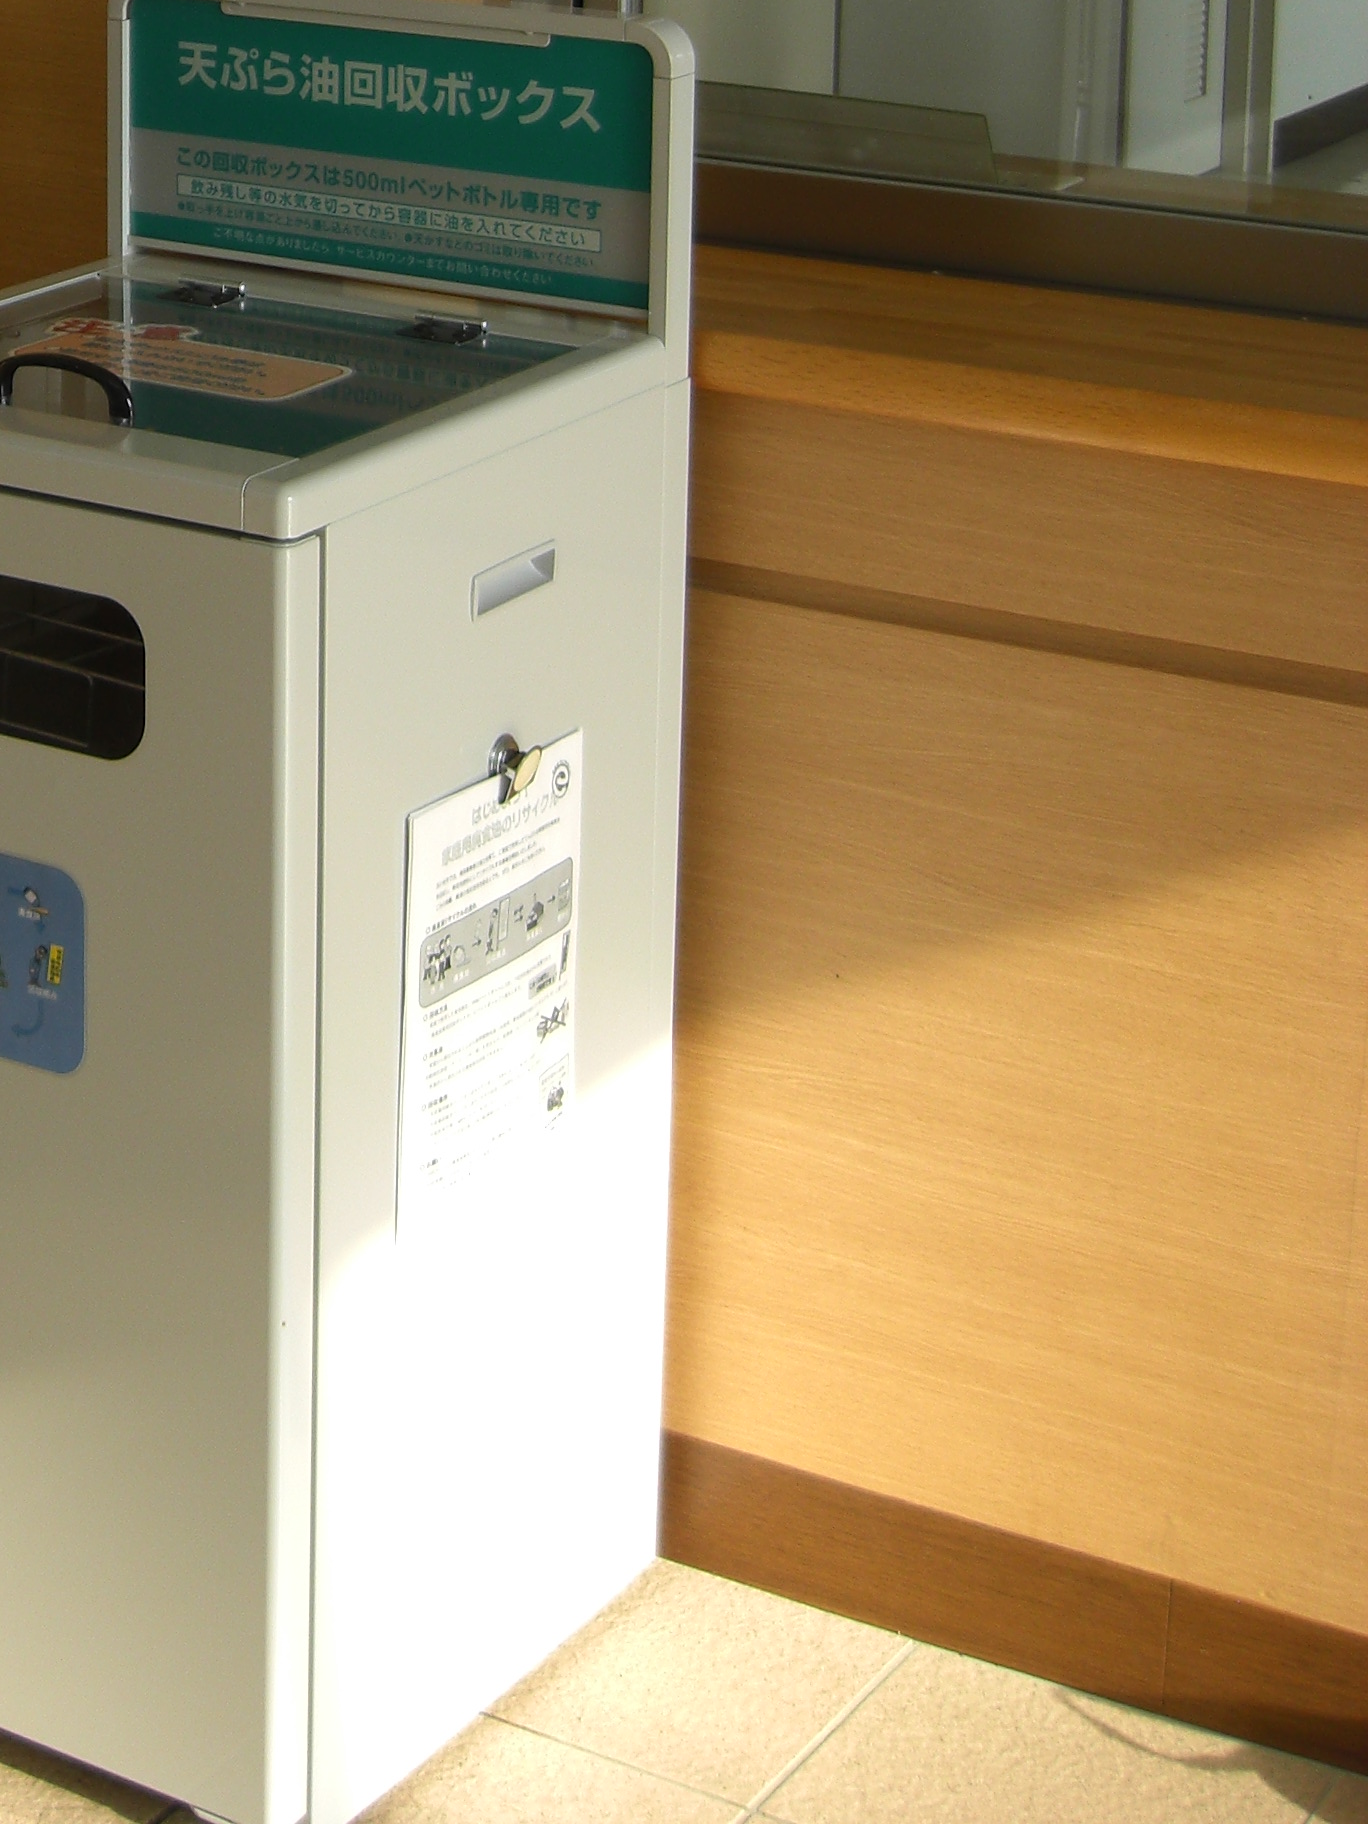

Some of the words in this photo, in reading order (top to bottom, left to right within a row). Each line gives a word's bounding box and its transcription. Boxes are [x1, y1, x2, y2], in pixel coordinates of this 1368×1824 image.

[177, 39, 602, 133] 天ぷら油回収ボックス
[176, 146, 602, 221] この回収ボックスは500mlペットボトル専用です
[190, 179, 586, 246] 飲み残し等の水気を切ってから容器に油を入れてください
